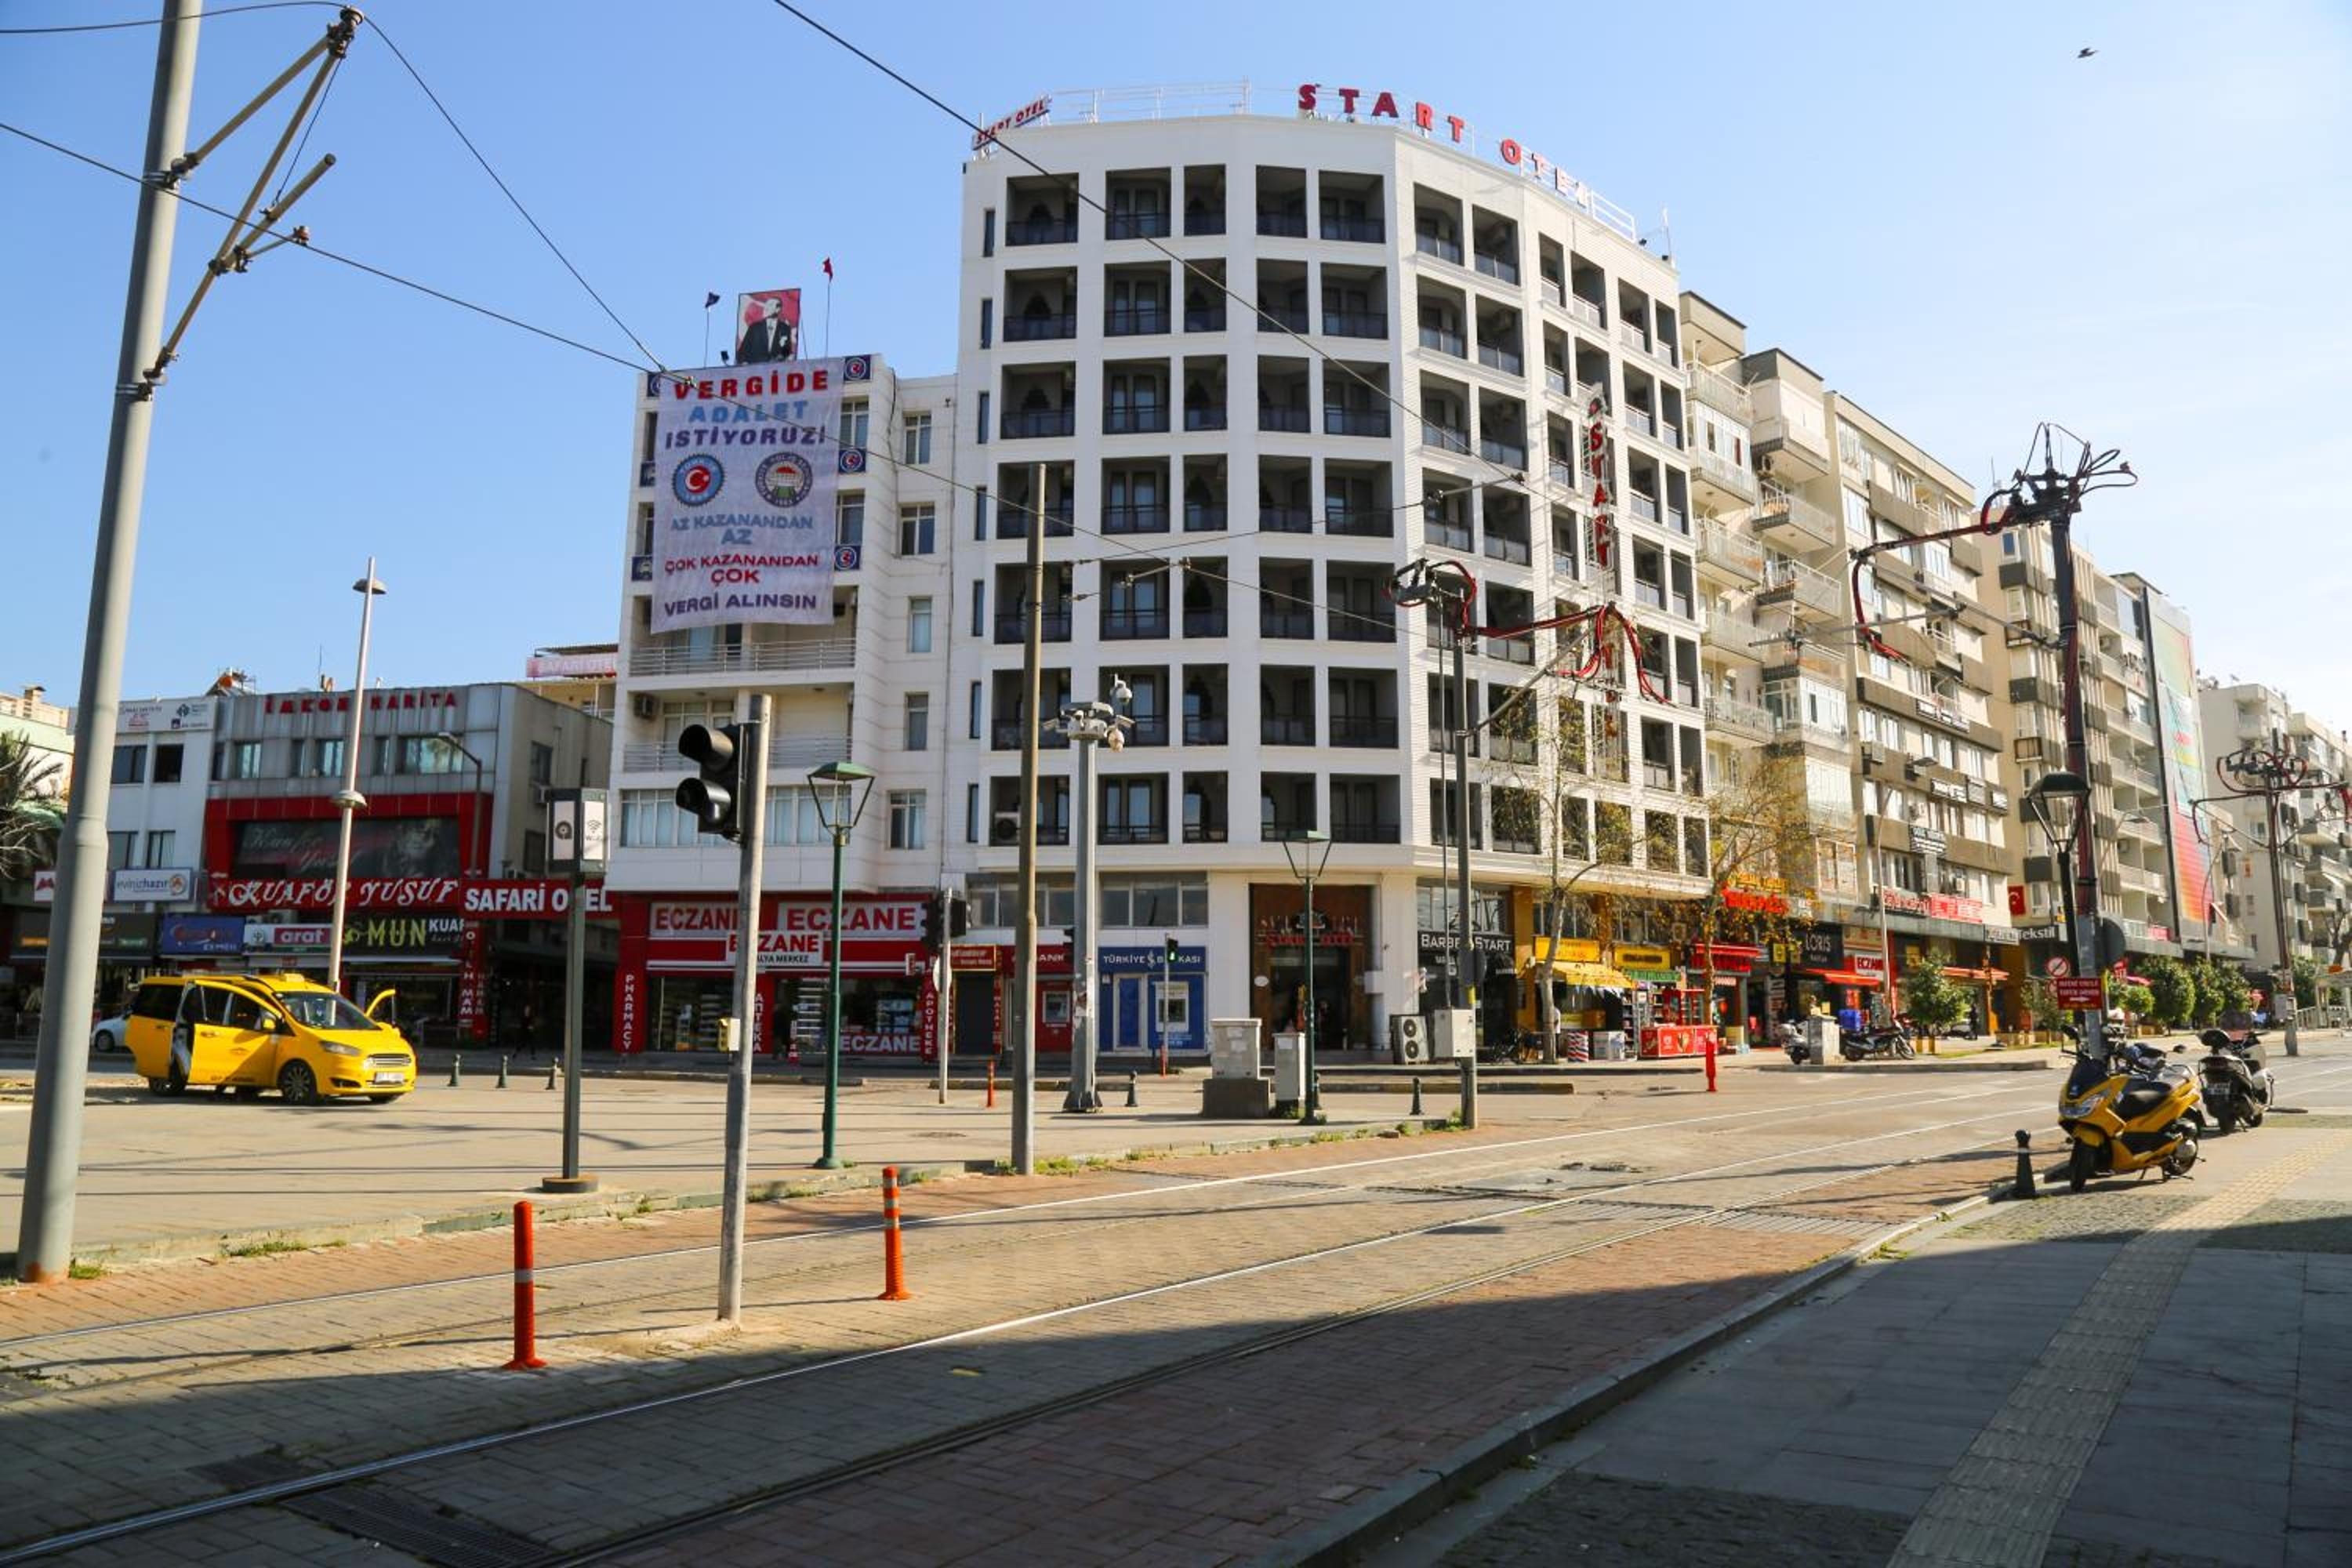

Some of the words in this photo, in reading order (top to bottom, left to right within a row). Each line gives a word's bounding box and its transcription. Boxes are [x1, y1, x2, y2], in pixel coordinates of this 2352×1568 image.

[976, 117, 1011, 144] START
[1016, 100, 1044, 122] OTEL
[1298, 84, 1465, 143] START
[1500, 139, 1588, 208] OTEL
[674, 370, 829, 400] VERGİDE
[688, 401, 808, 424] ADALET
[1588, 420, 1610, 567] START
[671, 517, 690, 532] AZ
[693, 514, 814, 529] KAZANANDAN
[721, 528, 753, 545] AZ
[665, 557, 697, 575] ÇOK
[700, 554, 818, 567] KAZANANDAN
[710, 568, 760, 586] ÇOK
[665, 590, 719, 617] VERGİ
[726, 593, 817, 609] ALINSIN
[360, 877, 459, 906] YUSUF
[464, 883, 546, 912] SAFARİ
[551, 887, 614, 912] OEL
[729, 934, 818, 952] EZANE
[1475, 937, 1512, 951] START
[1806, 934, 1831, 953] LORIS
[1104, 953, 1145, 964] TÜRKİYE
[622, 975, 635, 1050] PHARMACY
[924, 993, 935, 1054] APOTHEKE
[840, 1036, 920, 1051] ECZANE
